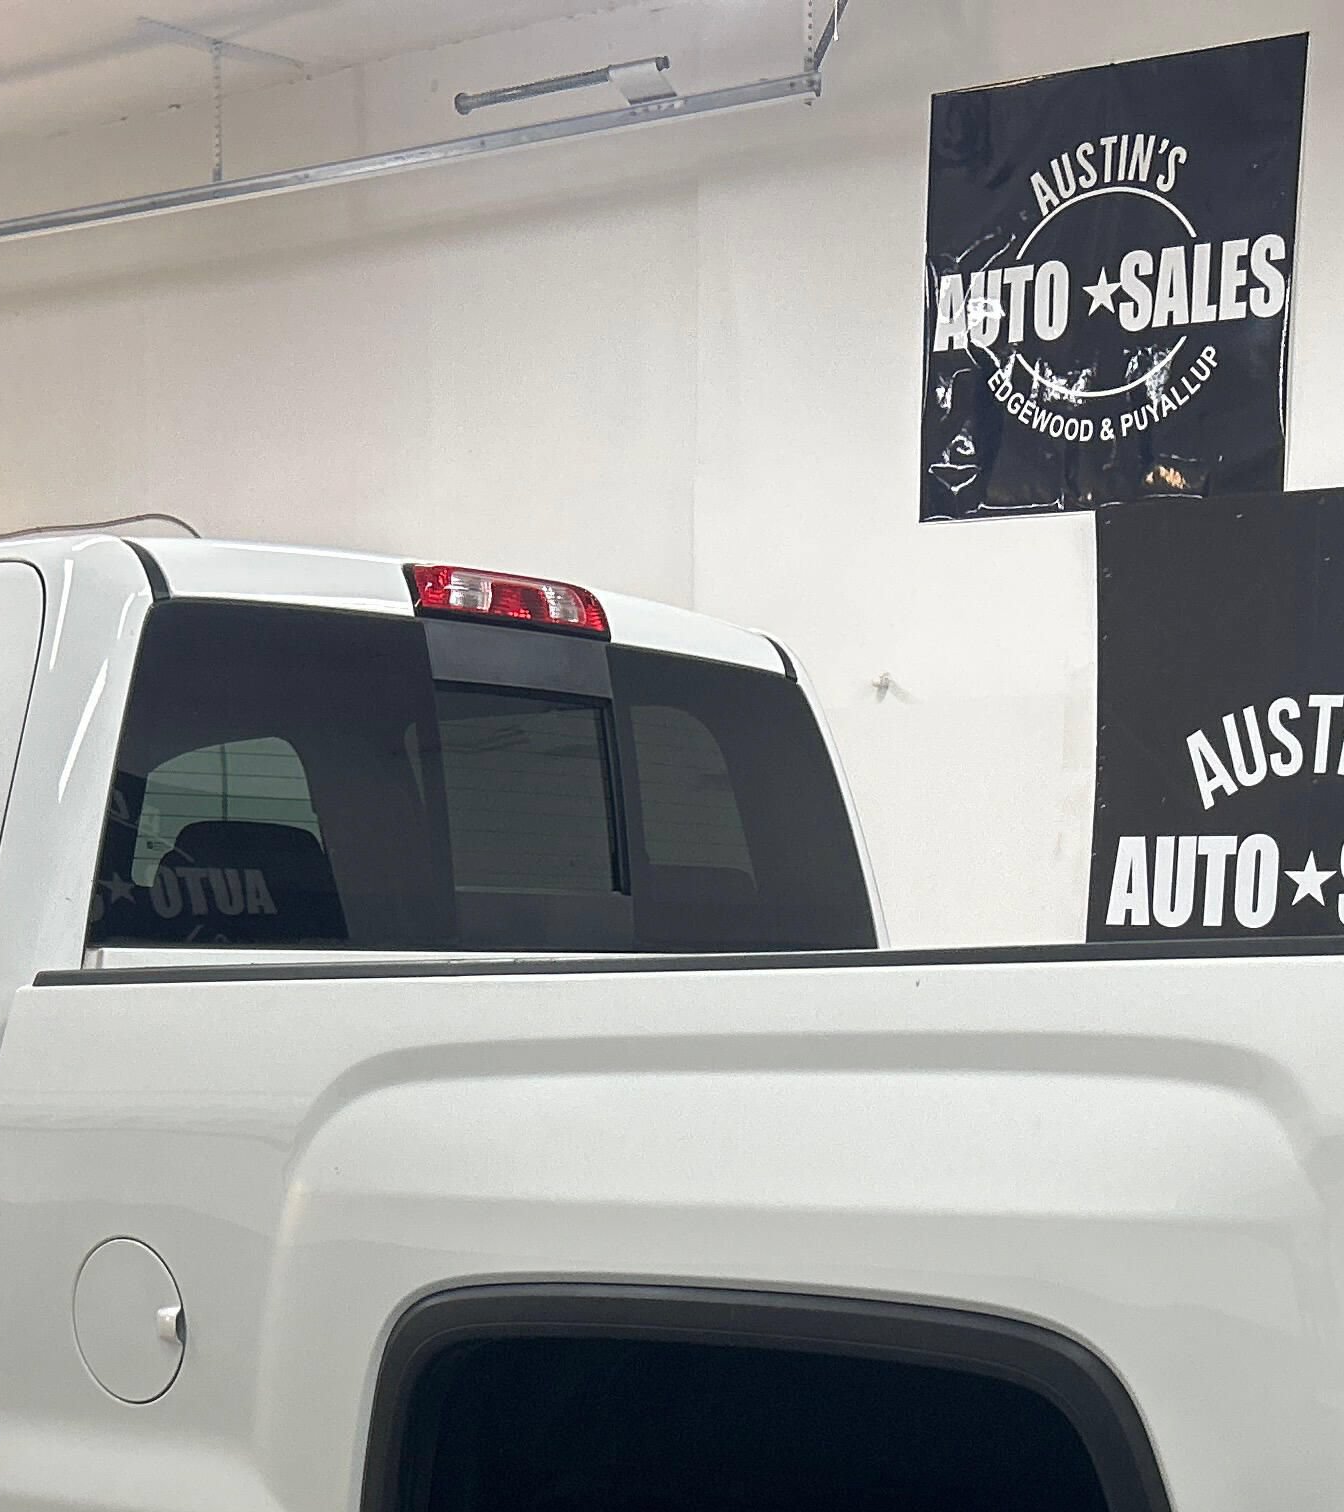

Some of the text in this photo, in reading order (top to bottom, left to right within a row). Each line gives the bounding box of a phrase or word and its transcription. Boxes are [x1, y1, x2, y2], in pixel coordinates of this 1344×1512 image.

[1029, 133, 1188, 217] AUSTIN'S
[933, 234, 1287, 354] AUTO SALES
[987, 345, 1219, 442] EDGEWOOD & PUYALLUP
[1105, 833, 1280, 929] AUTO
